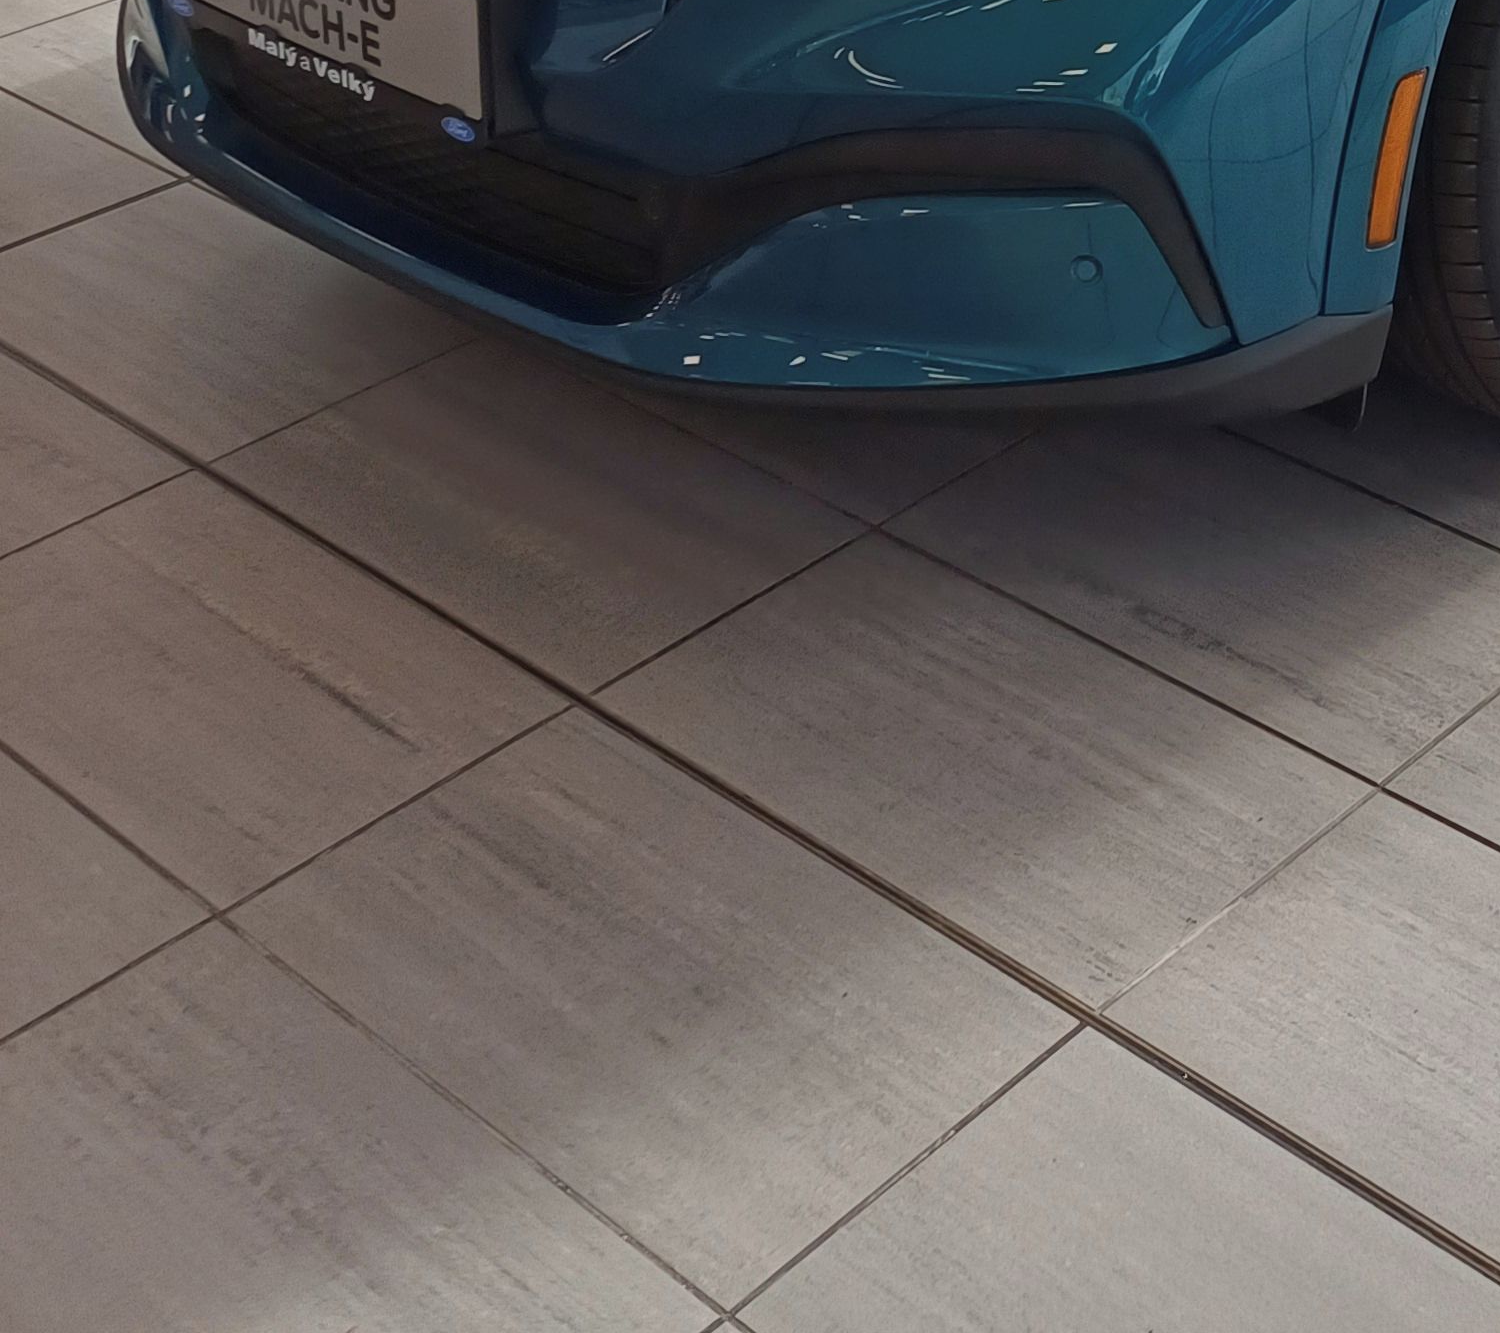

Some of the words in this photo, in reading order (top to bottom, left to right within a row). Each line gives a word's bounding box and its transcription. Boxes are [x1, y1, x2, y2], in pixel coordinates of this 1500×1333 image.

[248, 27, 297, 67] Malý
[299, 56, 311, 72] a
[312, 56, 376, 102] Velký
